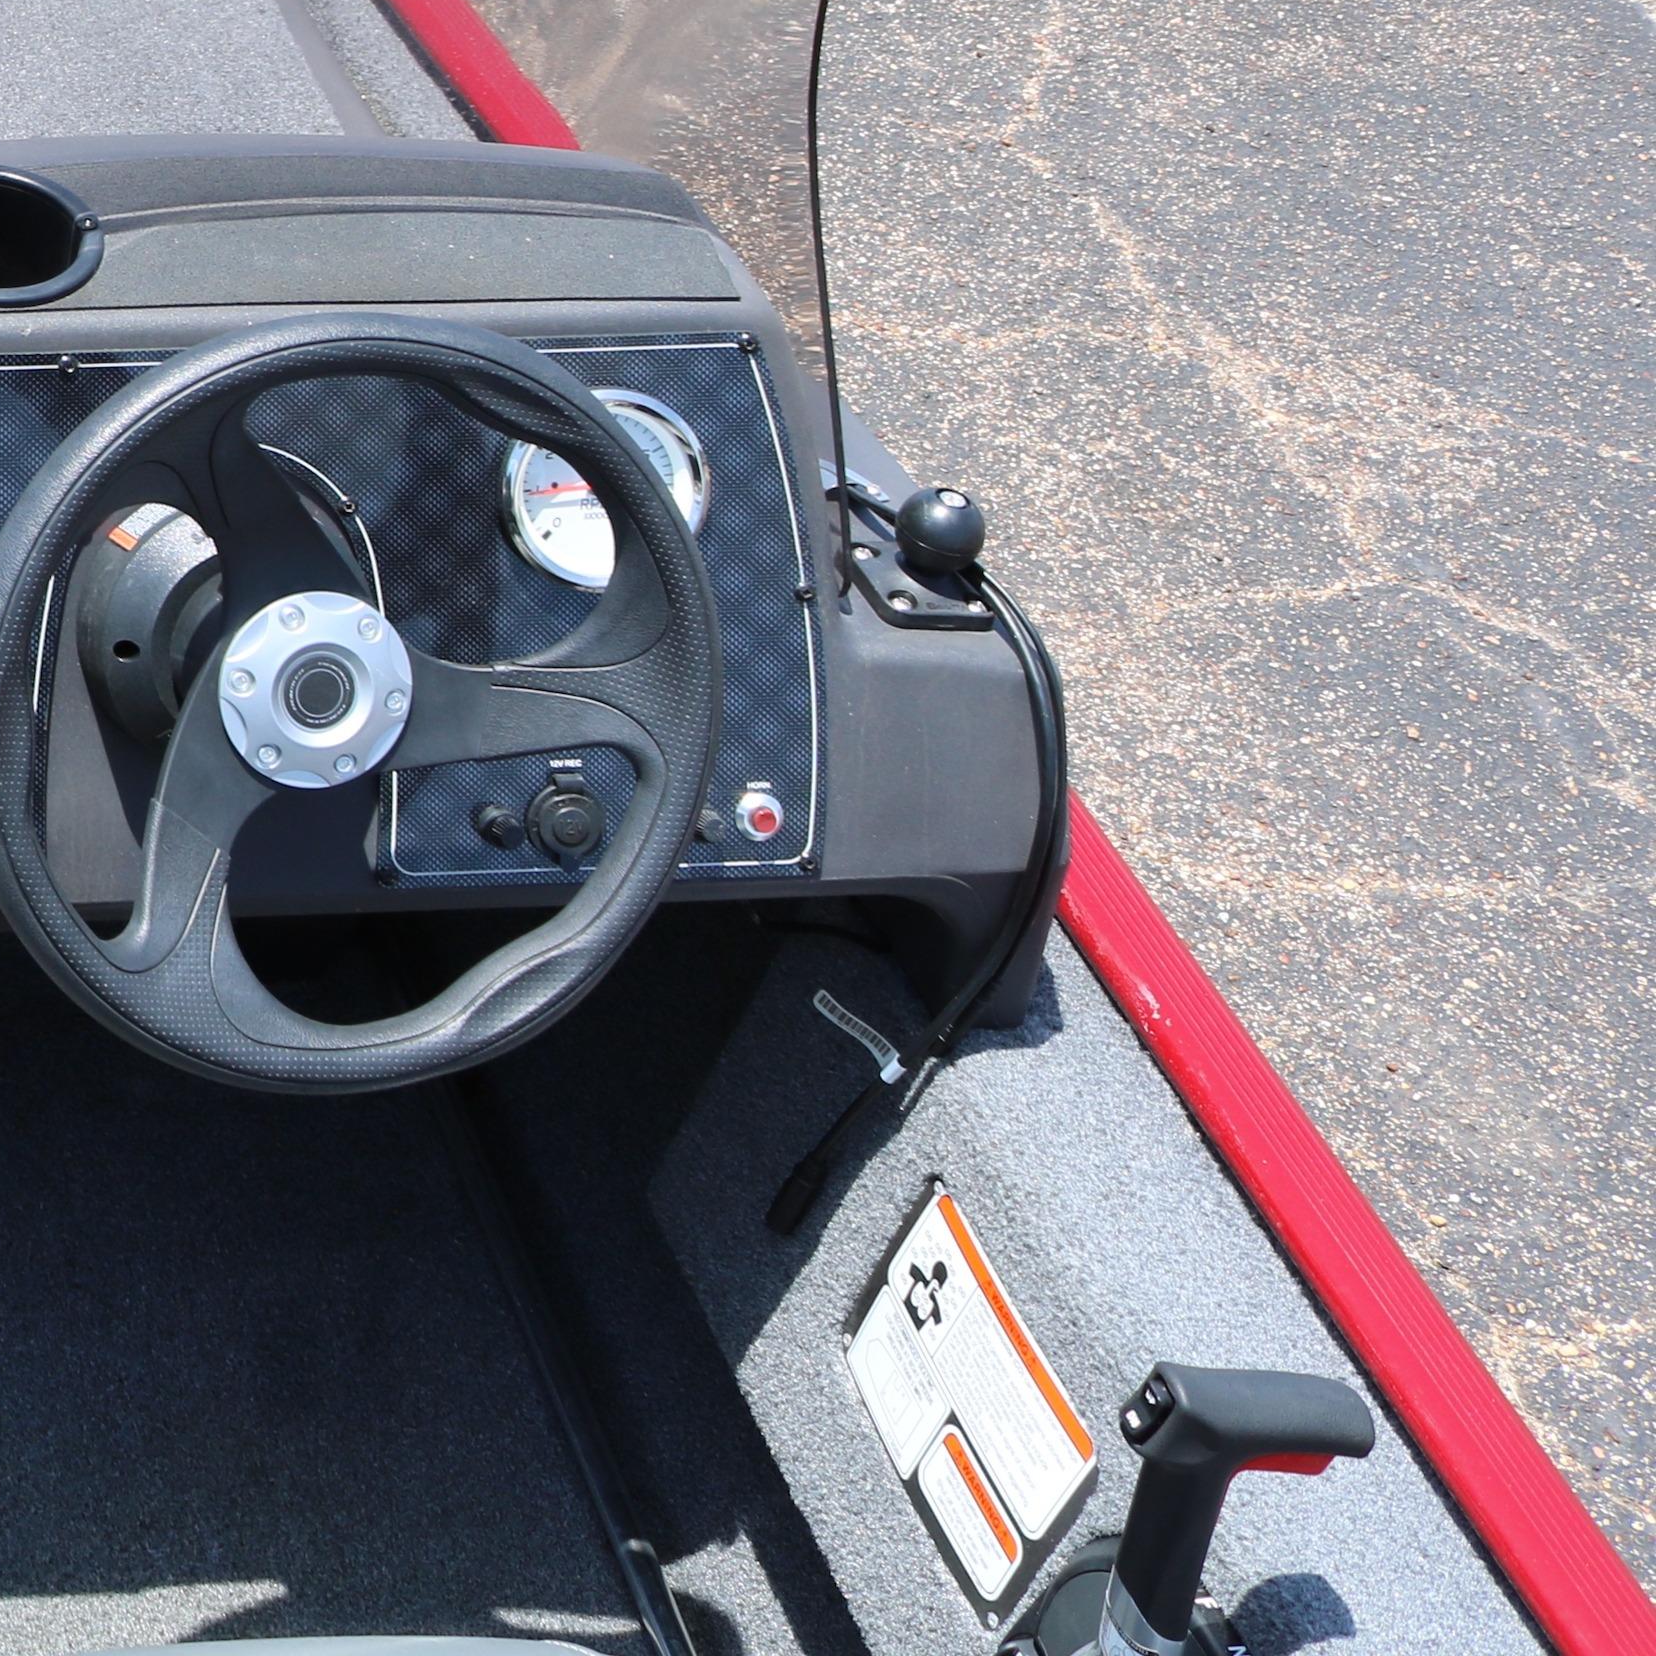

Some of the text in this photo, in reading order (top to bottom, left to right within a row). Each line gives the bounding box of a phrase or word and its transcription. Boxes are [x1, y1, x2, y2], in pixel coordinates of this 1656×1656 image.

[747, 781, 771, 789] HORN
[990, 1293, 1029, 1357] WARNING
[961, 1464, 1001, 1530] WARNING
